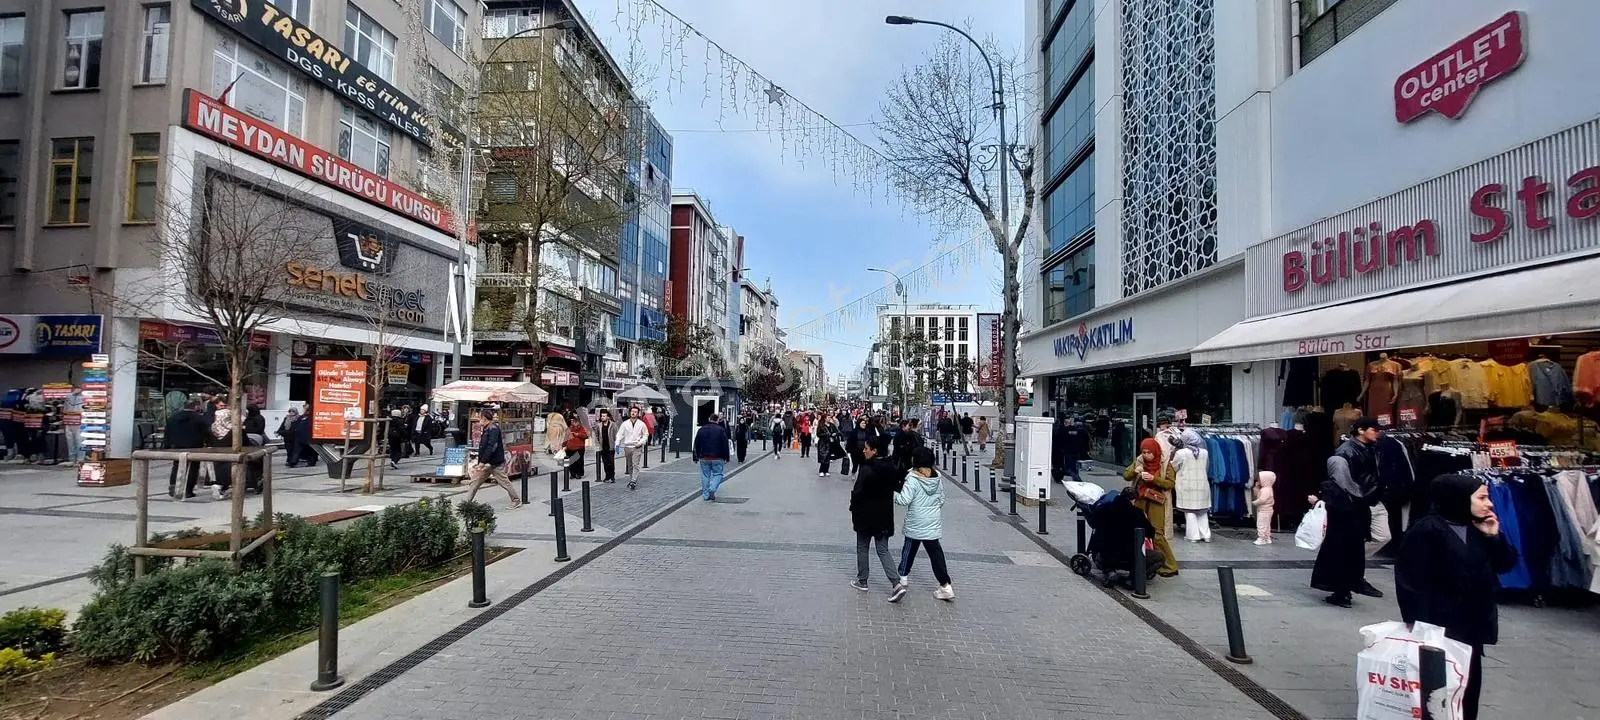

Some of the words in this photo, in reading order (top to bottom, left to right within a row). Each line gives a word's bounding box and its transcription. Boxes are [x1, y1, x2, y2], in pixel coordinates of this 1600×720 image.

[259, 4, 350, 75] TASARI
[1400, 22, 1511, 99] OUTLET
[286, 47, 323, 79] DGS
[337, 79, 375, 110] KPSS
[388, 112, 420, 138] ALES
[1420, 61, 1489, 107] center
[197, 101, 304, 169] MEYDAN
[311, 153, 388, 203] SÜRÜCÜ
[391, 190, 441, 226] KURSU
[1283, 217, 1440, 294] Bülüm
[1470, 165, 1600, 244] Sta
[55, 324, 96, 337] TASARI
[1053, 333, 1077, 357] VAKIF
[1090, 316, 1133, 349] KATILIM
[1299, 338, 1345, 355] Bülüm
[1354, 333, 1391, 350] Star
[1368, 672, 1386, 685] EV
